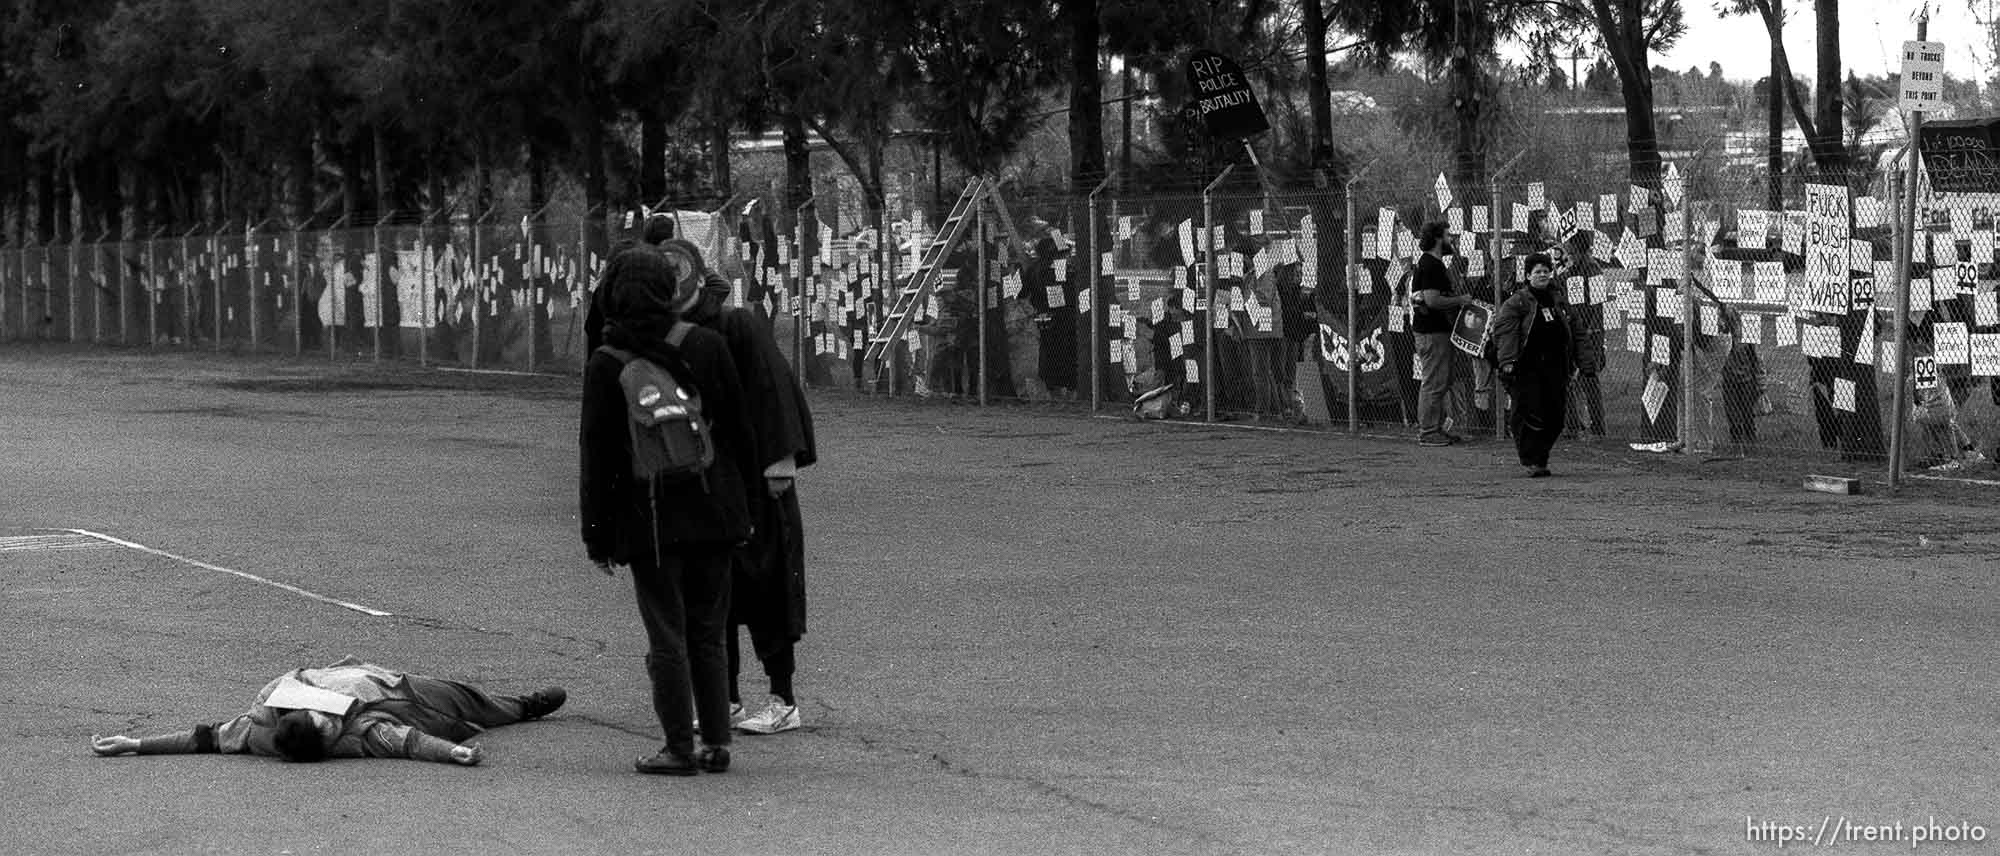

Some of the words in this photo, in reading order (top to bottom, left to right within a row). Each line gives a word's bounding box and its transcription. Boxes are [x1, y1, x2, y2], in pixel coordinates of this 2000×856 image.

[1192, 56, 1222, 78] RIP
[1907, 51, 1914, 60] NO
[1920, 52, 1941, 62] TRUCKS
[1198, 72, 1238, 93] POLICE
[1912, 71, 1933, 81] BEYOND
[1199, 89, 1250, 114] BRUTALITY
[1905, 90, 1918, 100] THIS
[1921, 91, 1937, 101] POINT
[1810, 193, 1846, 219] FUCK
[1812, 222, 1847, 249] BUSH
[1819, 250, 1842, 276] NO
[1809, 281, 1847, 309] WARS
